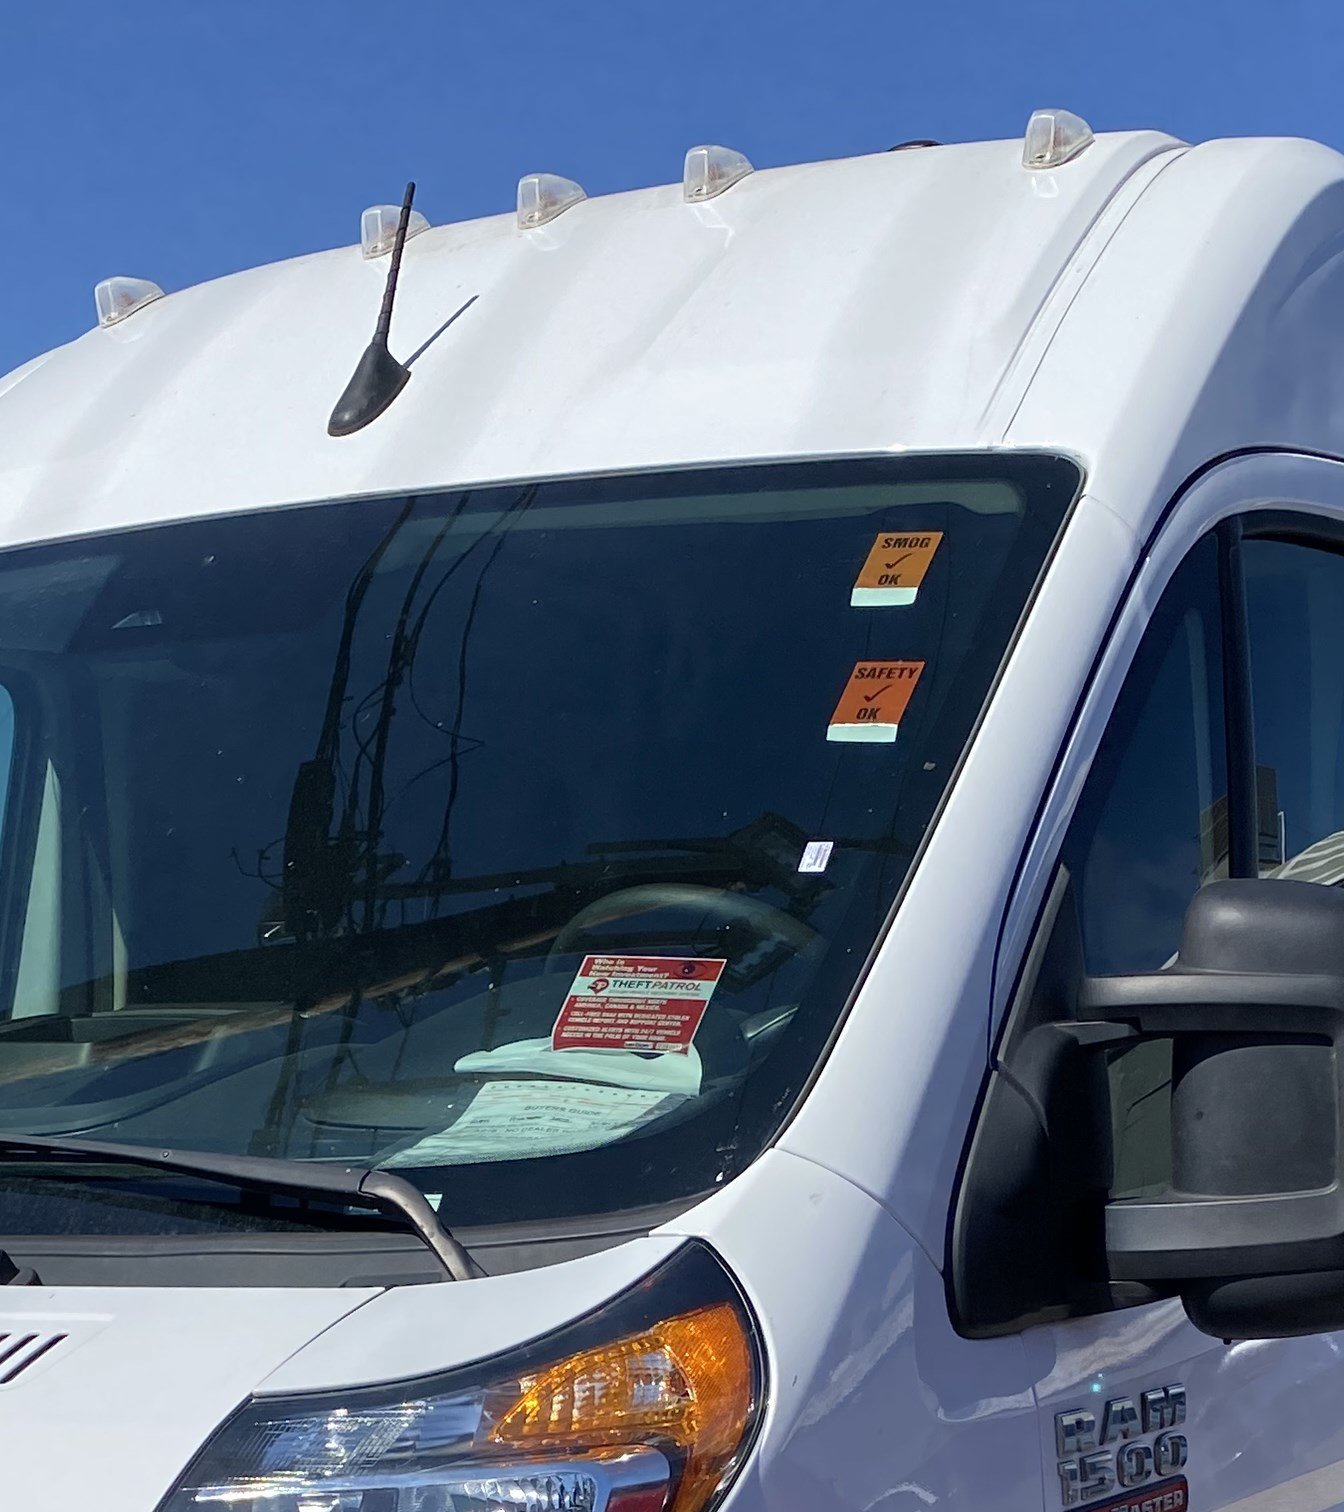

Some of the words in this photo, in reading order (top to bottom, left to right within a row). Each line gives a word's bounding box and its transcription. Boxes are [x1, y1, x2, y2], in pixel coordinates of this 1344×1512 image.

[881, 537, 931, 549] SMOG
[877, 573, 901, 585] OK
[854, 667, 919, 679] SAFETY
[856, 707, 881, 720] OK
[1054, 1383, 1187, 1457] RAM
[1057, 1430, 1188, 1506] 1500
